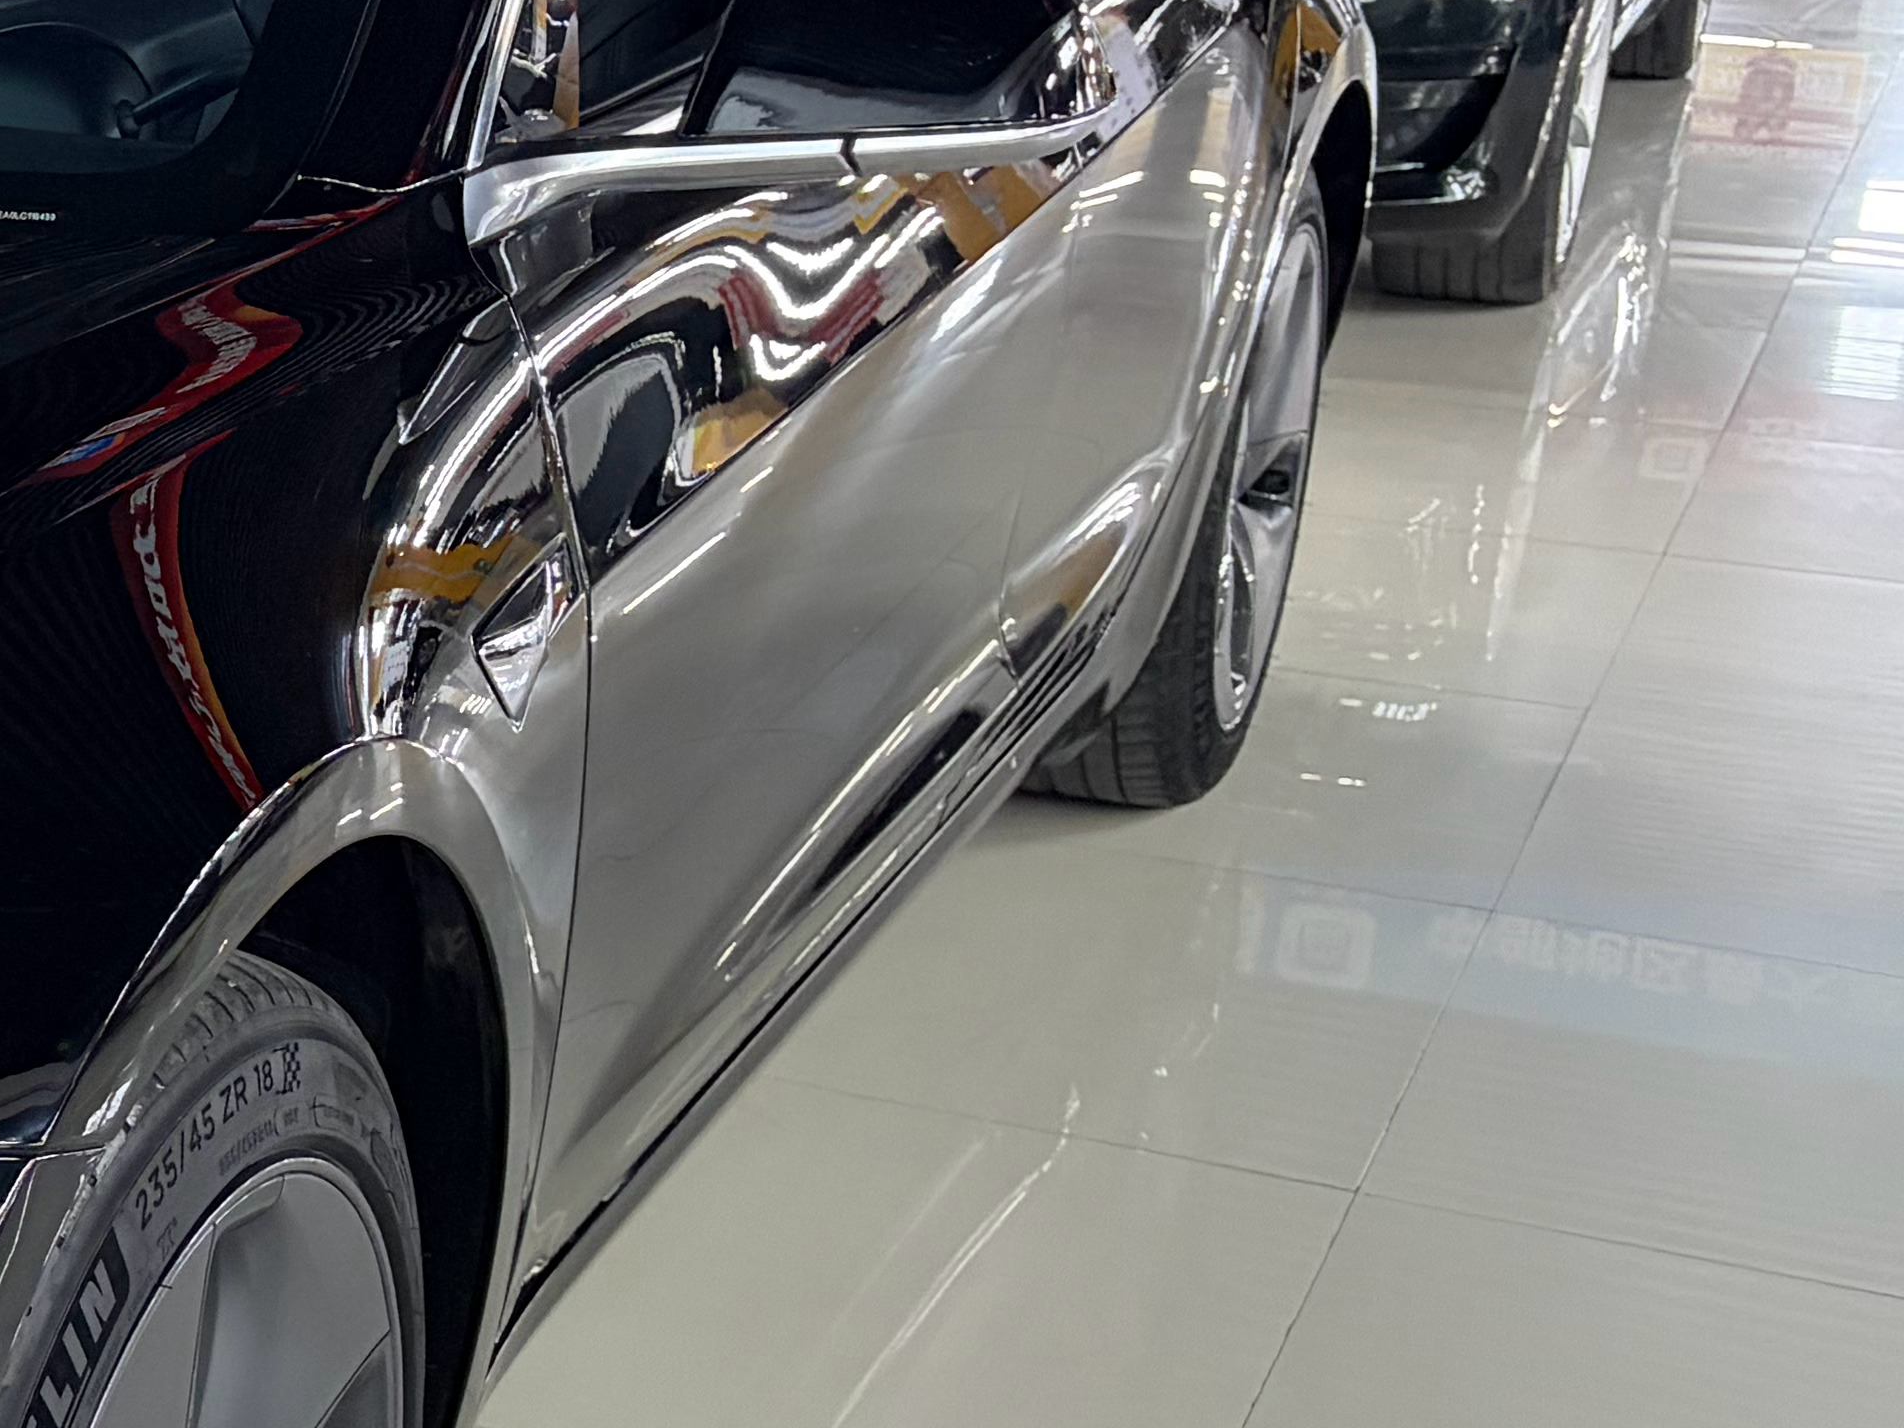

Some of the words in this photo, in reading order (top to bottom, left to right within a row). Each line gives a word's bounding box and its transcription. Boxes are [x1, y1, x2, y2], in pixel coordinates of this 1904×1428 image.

[135, 1102, 216, 1231] 235/45
[219, 1075, 248, 1124] ZR
[253, 1059, 274, 1097] 18
